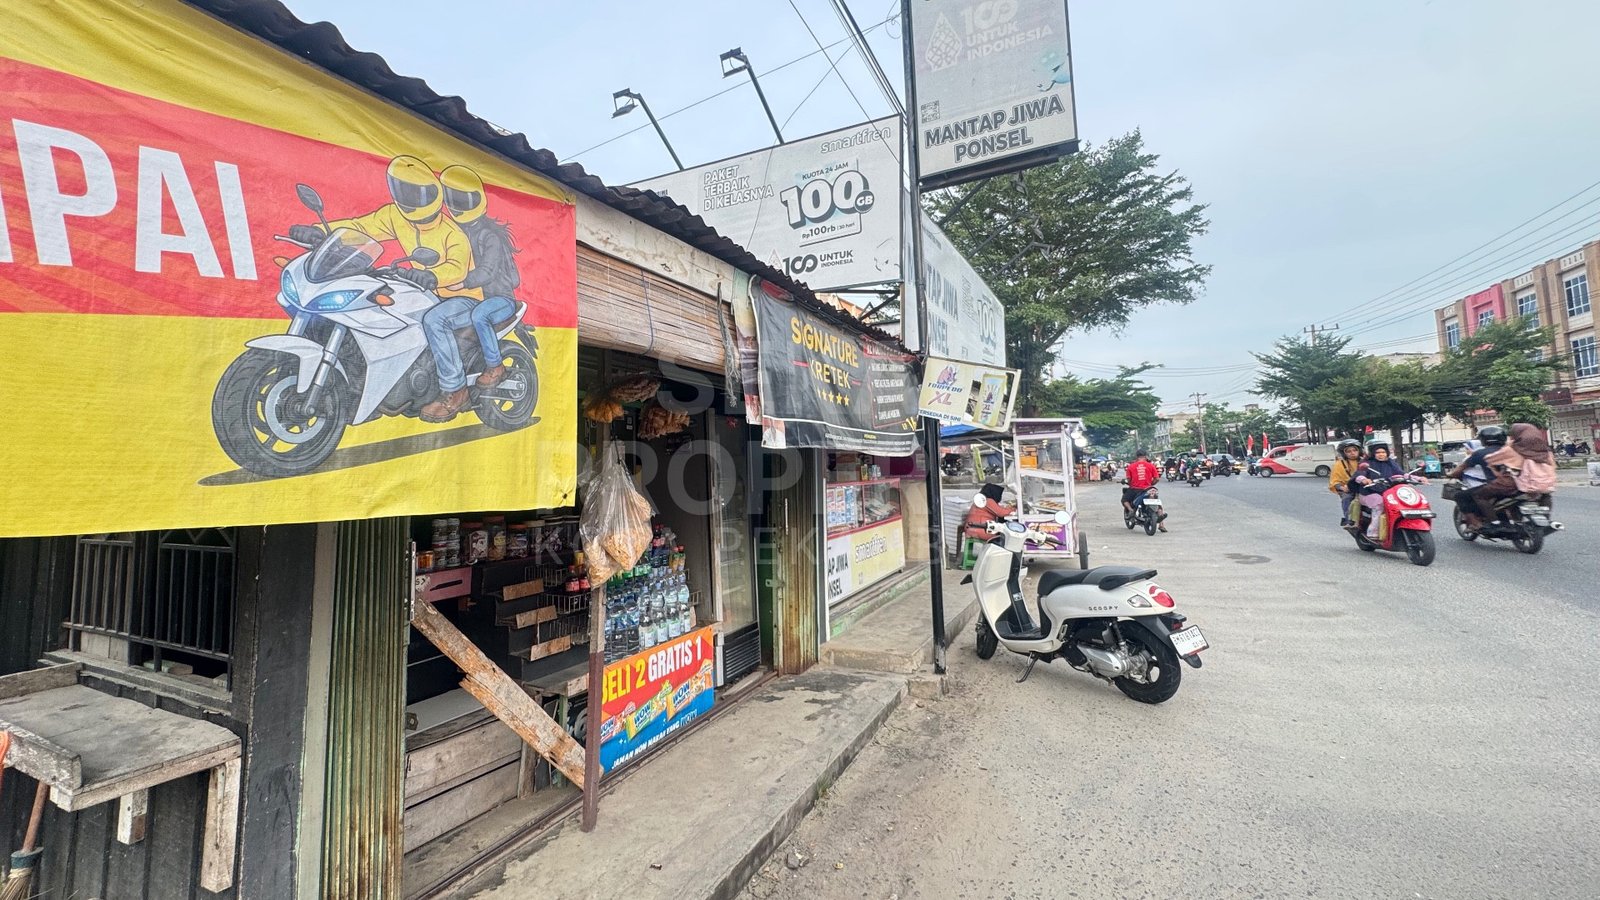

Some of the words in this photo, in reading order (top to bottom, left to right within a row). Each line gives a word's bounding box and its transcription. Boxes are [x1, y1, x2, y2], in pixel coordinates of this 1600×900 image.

[966, 20, 1019, 47] UNTUK
[967, 25, 1053, 61] INDONESIA
[925, 110, 1006, 149] MANTAP
[1007, 94, 1065, 126] JIWA
[820, 127, 890, 154] smartfren
[954, 126, 1034, 163] PONSEL
[704, 165, 739, 184] PAKET
[802, 169, 824, 180] KUOTA
[834, 162, 849, 171] JAM
[0, 118, 258, 280] PAI
[704, 176, 749, 198] TERBAIK
[704, 198, 714, 211] DI
[716, 184, 774, 208] KELASNYA
[780, 170, 869, 229] 100
[856, 195, 873, 206] GB
[820, 250, 854, 262] UNTUK
[820, 259, 854, 268] INDONESIA
[791, 317, 859, 368] SIGNATURE
[809, 357, 851, 389] KRETEK
[928, 390, 952, 406] XL
[919, 409, 942, 418] ERSEDIA
[635, 659, 646, 689] 2
[648, 640, 692, 682] GRATIS
[695, 636, 701, 660] 1
